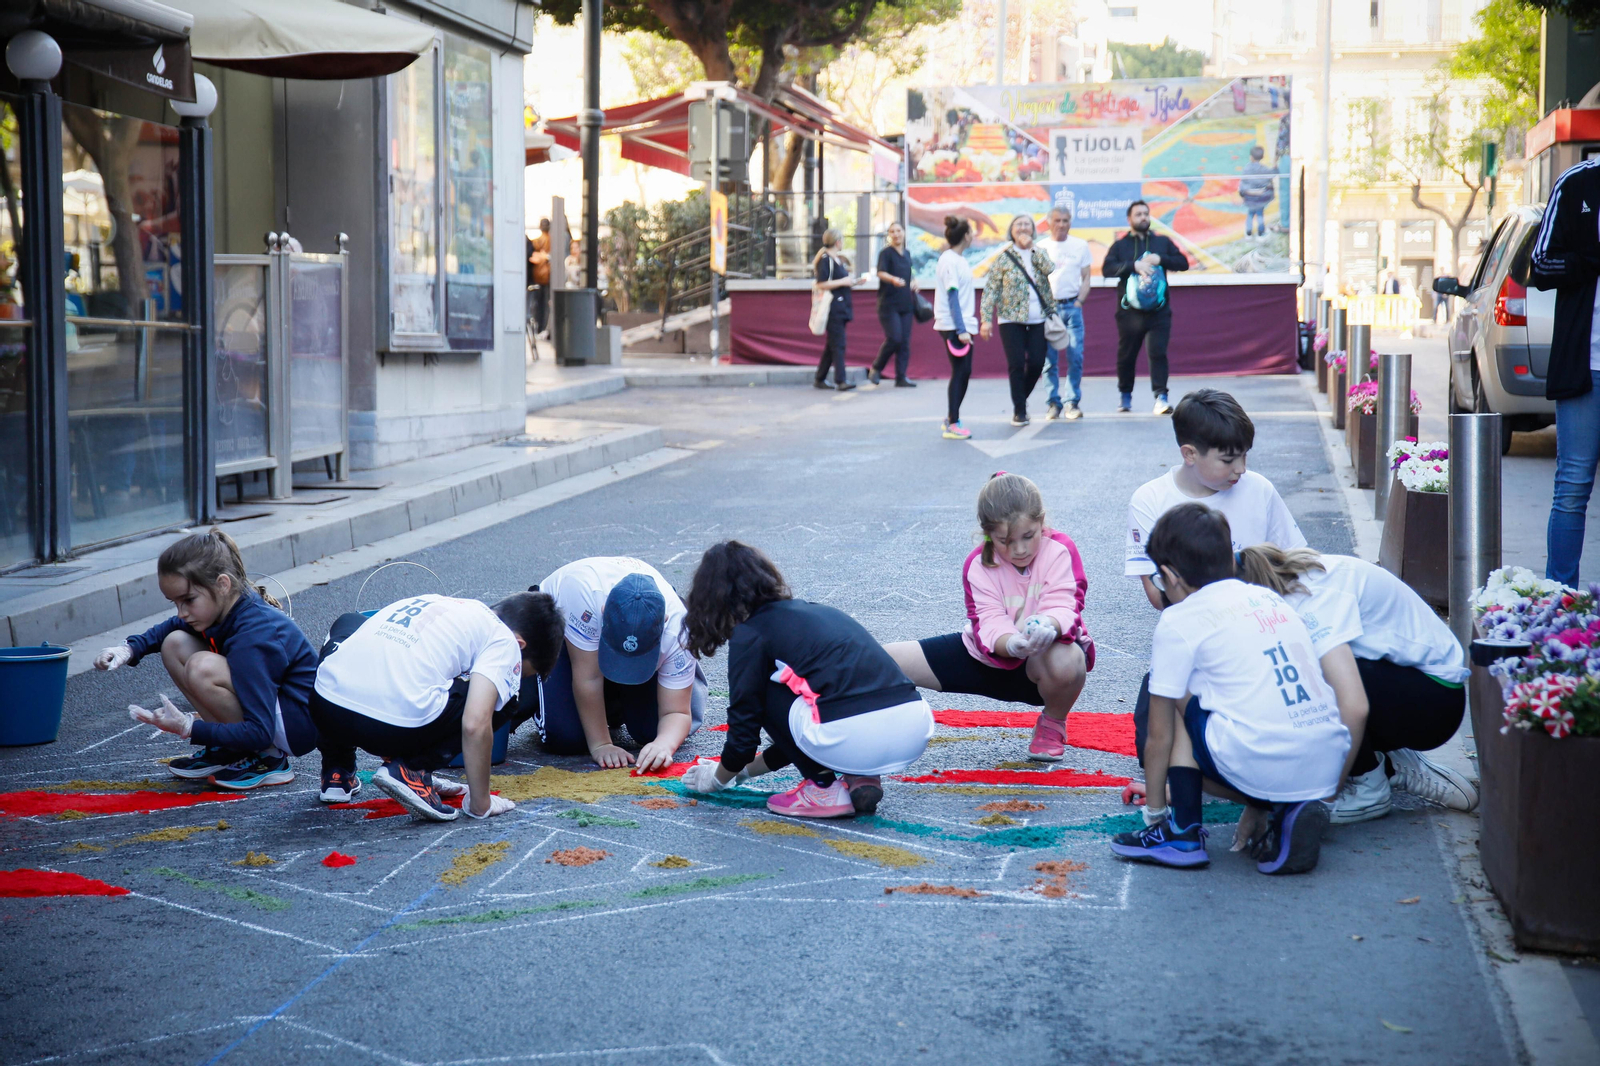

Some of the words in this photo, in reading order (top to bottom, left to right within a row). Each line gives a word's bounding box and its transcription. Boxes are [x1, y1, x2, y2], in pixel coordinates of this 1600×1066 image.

[146, 72, 174, 90] CANDELAS
[1002, 89, 1057, 126] Virgen
[1058, 91, 1077, 114] de
[1072, 133, 1136, 152] TÍJOLA
[1077, 208, 1090, 219] de
[396, 605, 422, 617] JO
[1247, 596, 1262, 608] de
[386, 612, 412, 628] LA
[374, 630, 411, 649] Almanzora
[387, 625, 406, 637] perla
[406, 632, 420, 644] del
[1262, 641, 1289, 666] TÍ
[1273, 664, 1299, 687] JO
[1280, 684, 1311, 707] LA
[1288, 710, 1299, 720] La
[1300, 705, 1318, 718] perla
[1318, 702, 1329, 712] del
[1292, 715, 1330, 729] Almanzora
